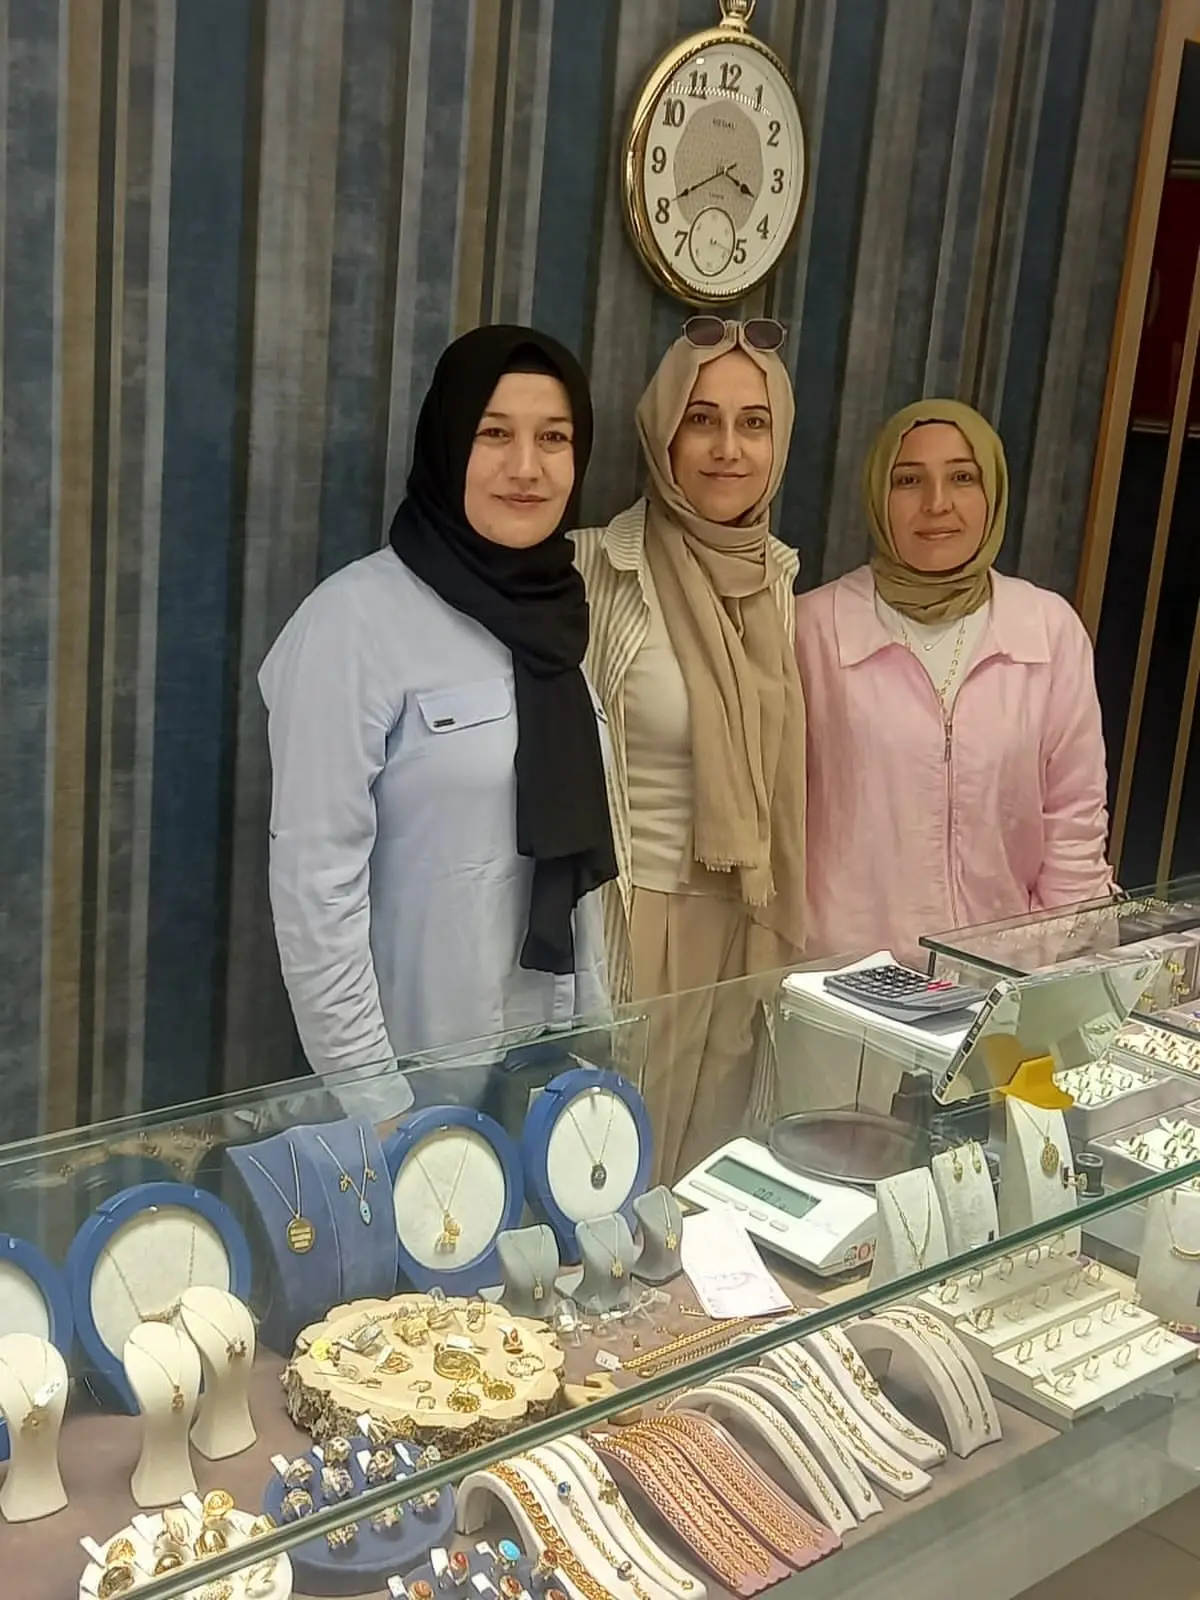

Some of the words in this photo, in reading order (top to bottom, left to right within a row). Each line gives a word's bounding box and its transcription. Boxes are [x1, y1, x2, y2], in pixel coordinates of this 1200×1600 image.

[688, 70, 708, 100] 11
[719, 62, 743, 92] 12
[754, 85, 763, 112] 1
[662, 98, 685, 128] 10
[767, 120, 781, 147] 2
[651, 146, 667, 174] 9
[771, 168, 785, 194] 3
[655, 197, 670, 224] 8
[756, 214, 769, 240] 4
[673, 231, 688, 257] 7
[733, 239, 748, 264] 5
